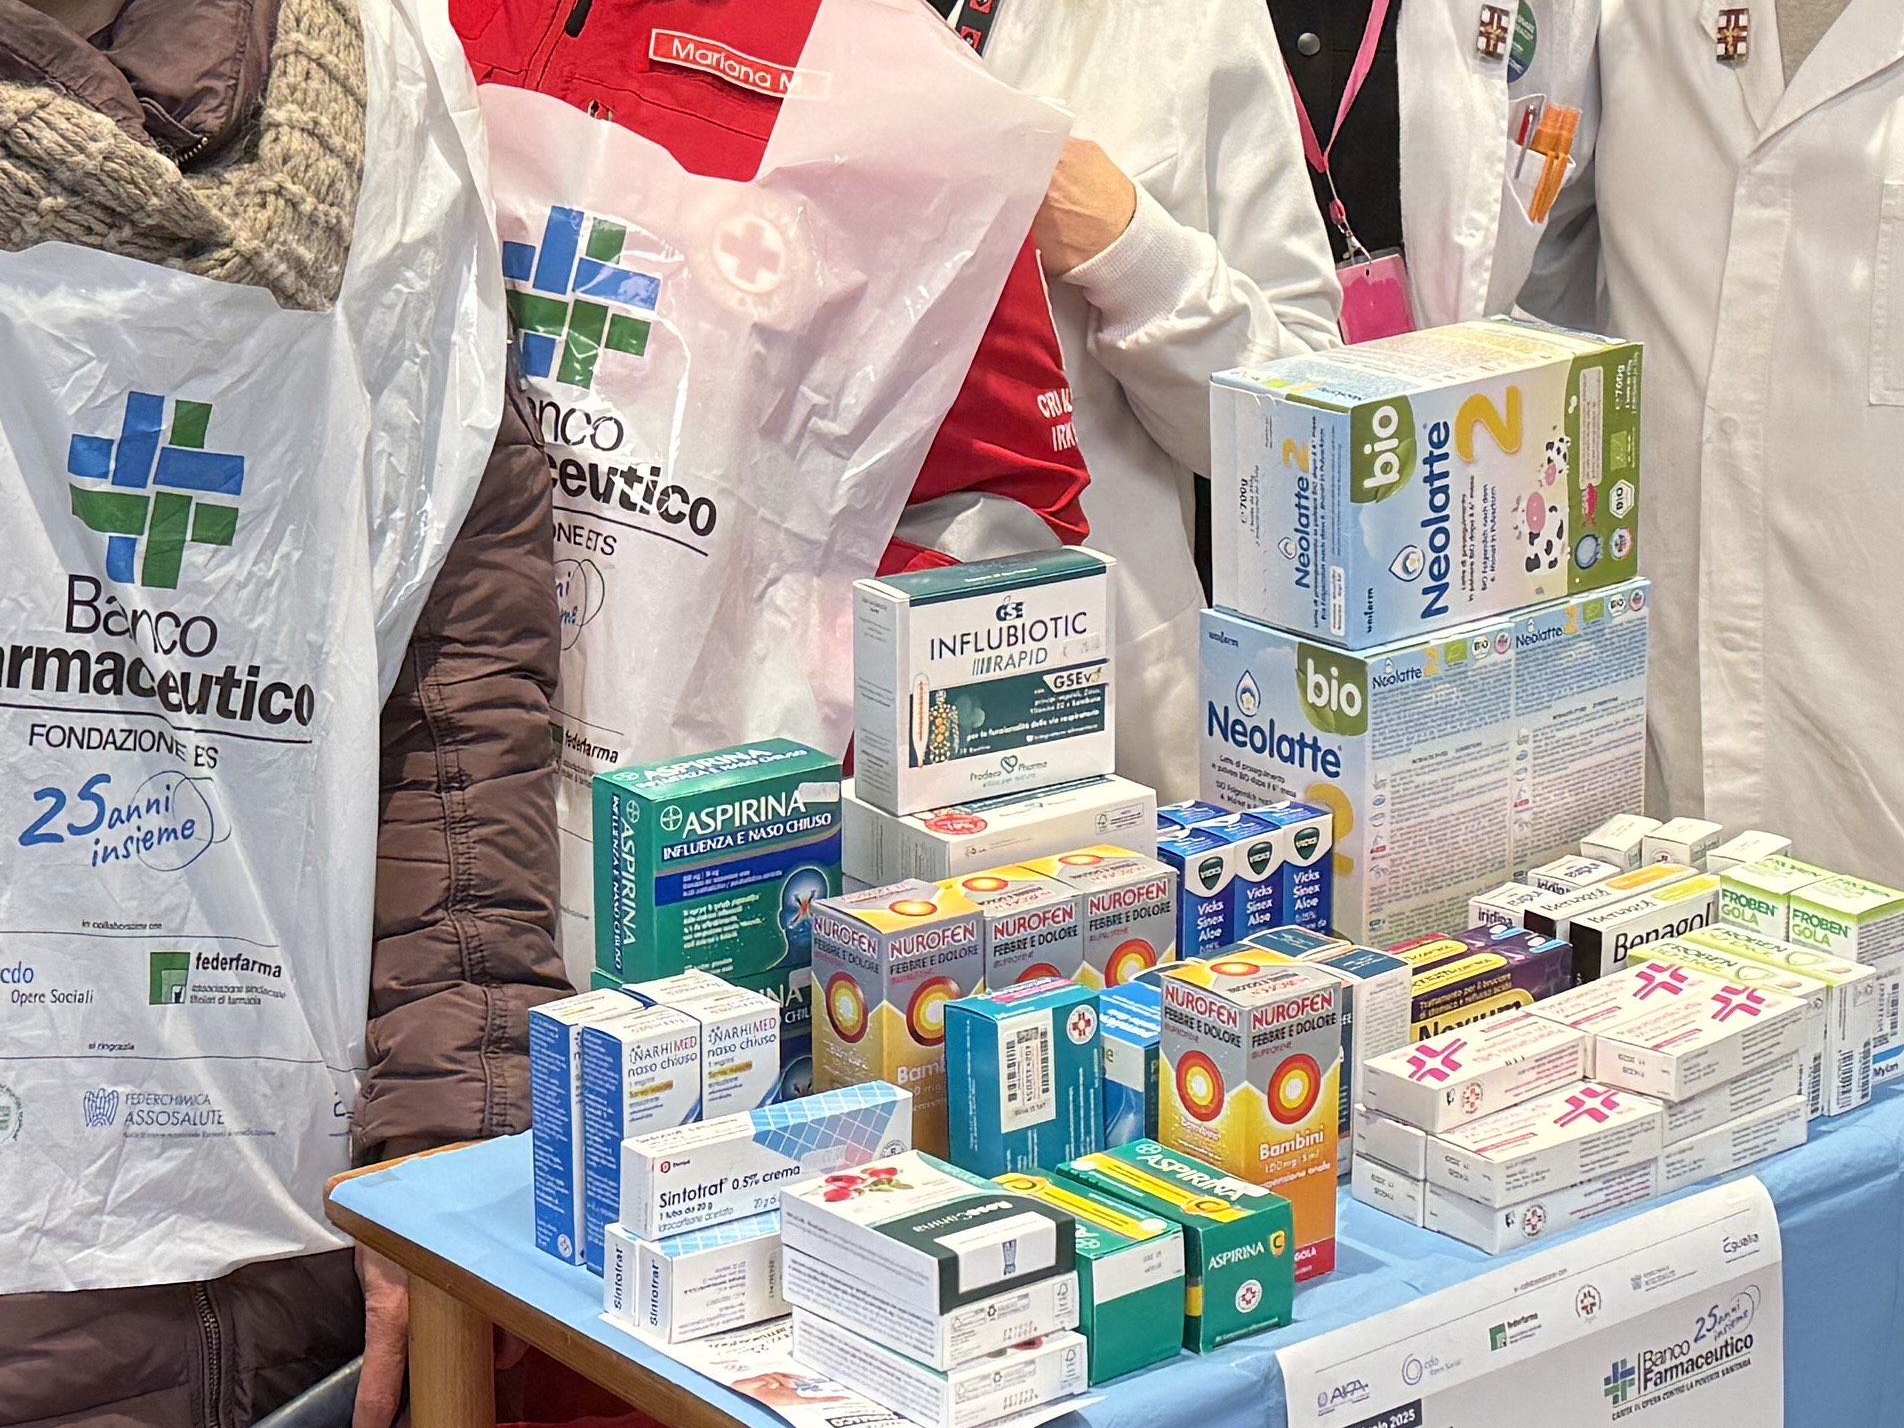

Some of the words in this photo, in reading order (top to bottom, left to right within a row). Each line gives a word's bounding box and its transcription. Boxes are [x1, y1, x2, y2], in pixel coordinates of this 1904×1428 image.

[671, 38, 772, 90] Mariana
[1363, 403, 1398, 488] bio
[1457, 386, 1524, 463] 2
[1421, 419, 1450, 620] Neolatte
[64, 573, 218, 658] Banco
[930, 611, 1088, 660] INFLUBIOTIC
[1207, 701, 1343, 778] Neolatte
[106, 784, 171, 831] anni
[683, 791, 807, 838] ASPIRINA
[90, 812, 197, 871] insieme
[662, 834, 729, 861] INFLUENZA
[734, 828, 744, 846] E
[747, 822, 784, 845] NASO
[788, 812, 832, 838] CHIUSO
[992, 904, 1076, 942] NUROFEN
[1723, 889, 1779, 915] FROBEN
[1723, 906, 1759, 927] GOLA
[889, 921, 977, 960] NUROFEN
[1614, 903, 1713, 958] Benagol
[0, 963, 34, 986] cdo
[194, 952, 282, 978] federfarma
[10, 989, 45, 1006] Opere
[49, 987, 94, 1006] Sociali
[706, 1043, 737, 1059] naso
[740, 1031, 778, 1052] chiuso
[1251, 1031, 1292, 1053] FEBBRE
[1294, 1024, 1300, 1039] E
[1302, 1012, 1337, 1034] DOLORE
[125, 1108, 225, 1127] ASSOSALUTE
[762, 1164, 801, 1183] crema
[1207, 1241, 1265, 1272] ASPIRINA
[1642, 1339, 1690, 1373] Banco
[1643, 1332, 1754, 1391] Farmaceutico
